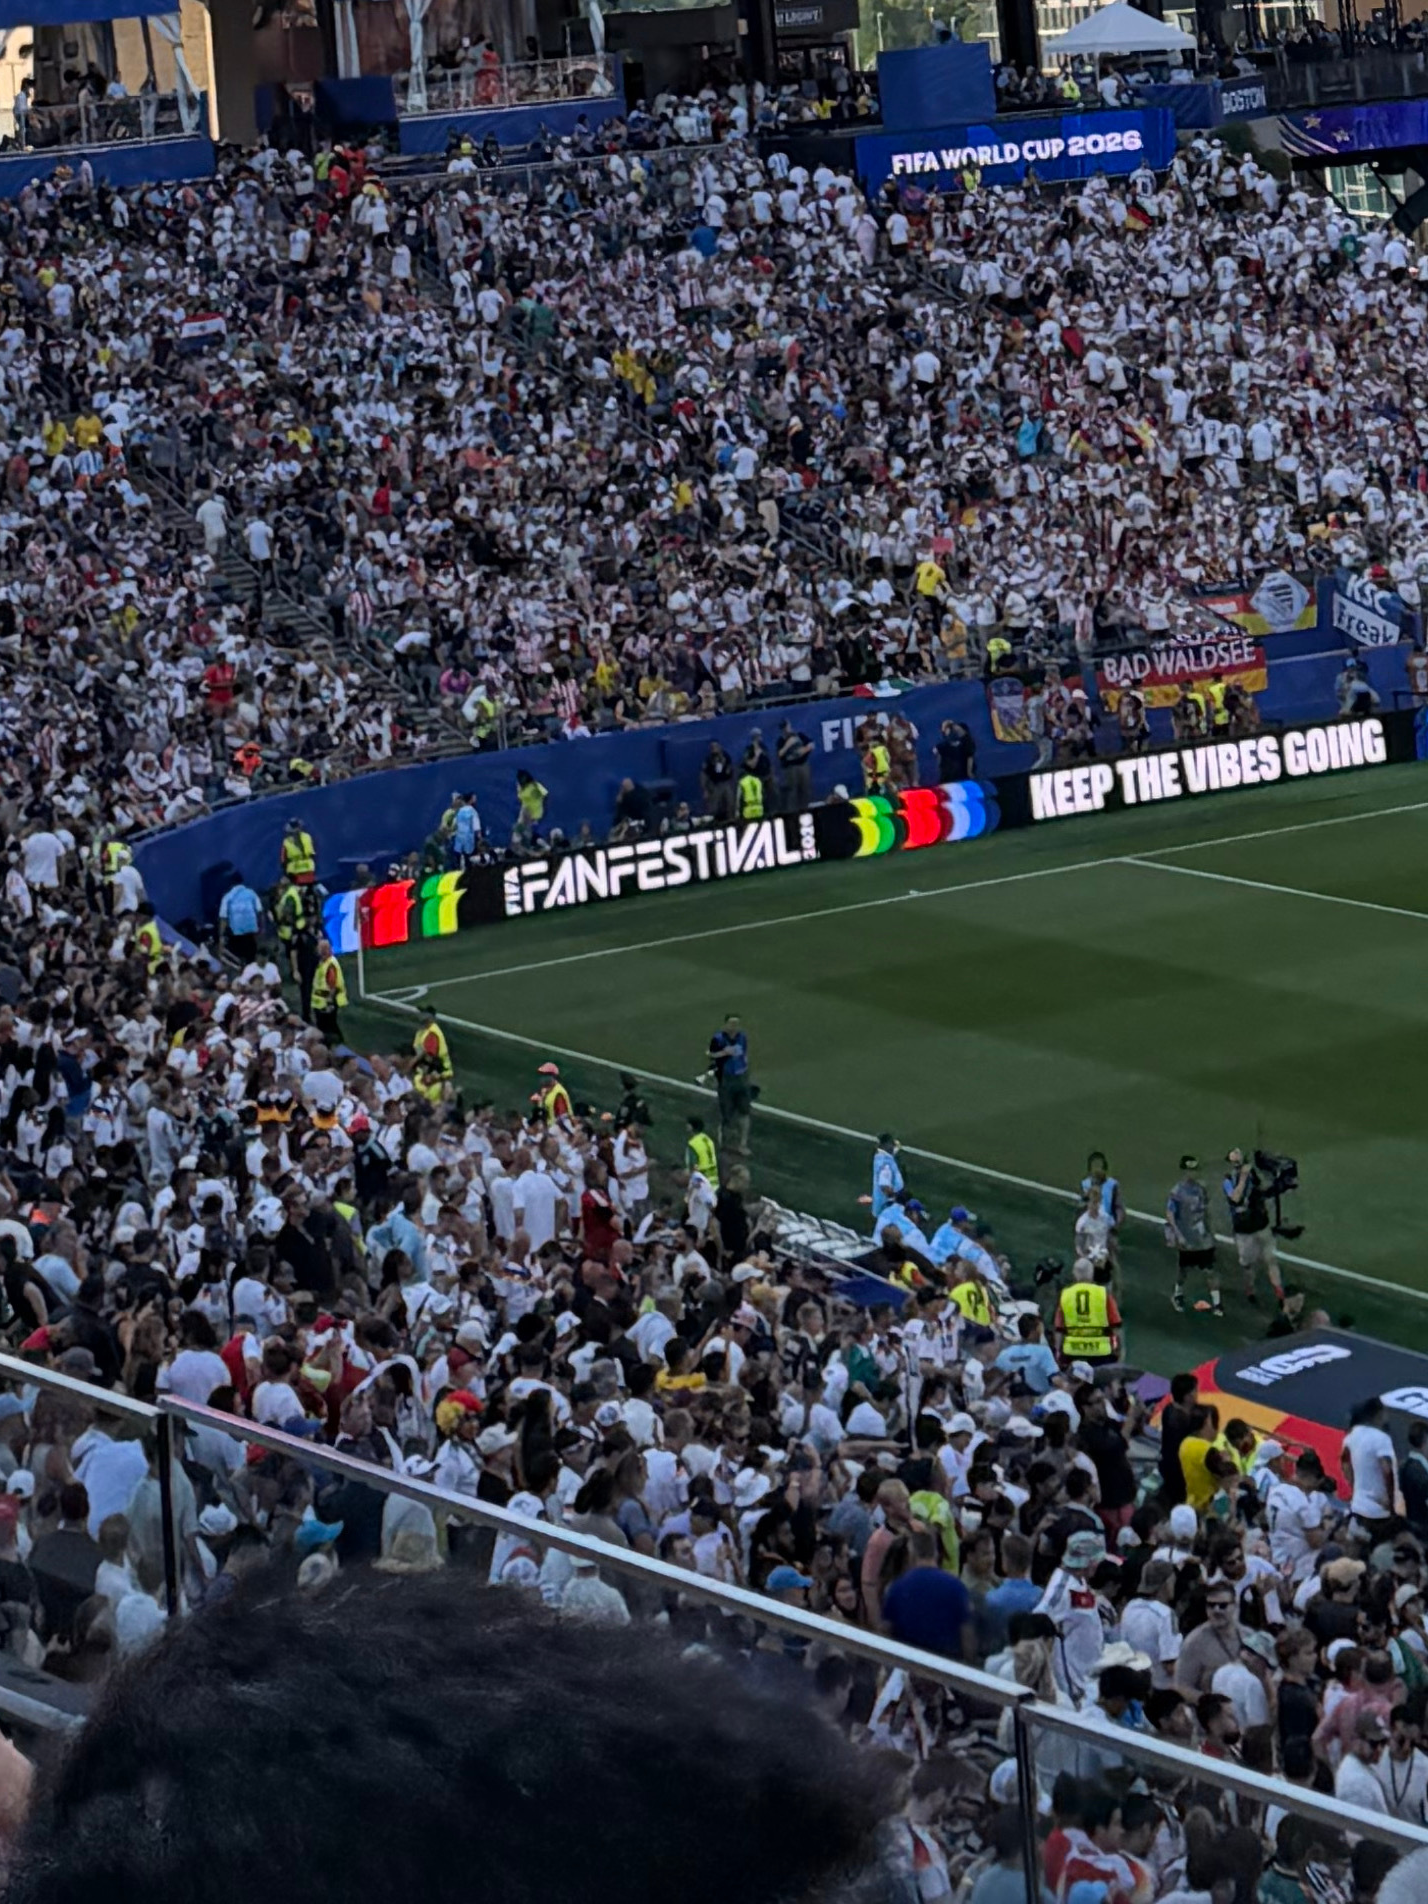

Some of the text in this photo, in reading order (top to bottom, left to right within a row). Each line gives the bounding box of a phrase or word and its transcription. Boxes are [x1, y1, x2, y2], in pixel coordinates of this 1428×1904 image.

[892, 130, 1142, 175] FIFA WORLD CUP 2026
[1103, 638, 1257, 685] BAD WALDSEE
[1029, 718, 1387, 820] KEEP THE VIBES GOING
